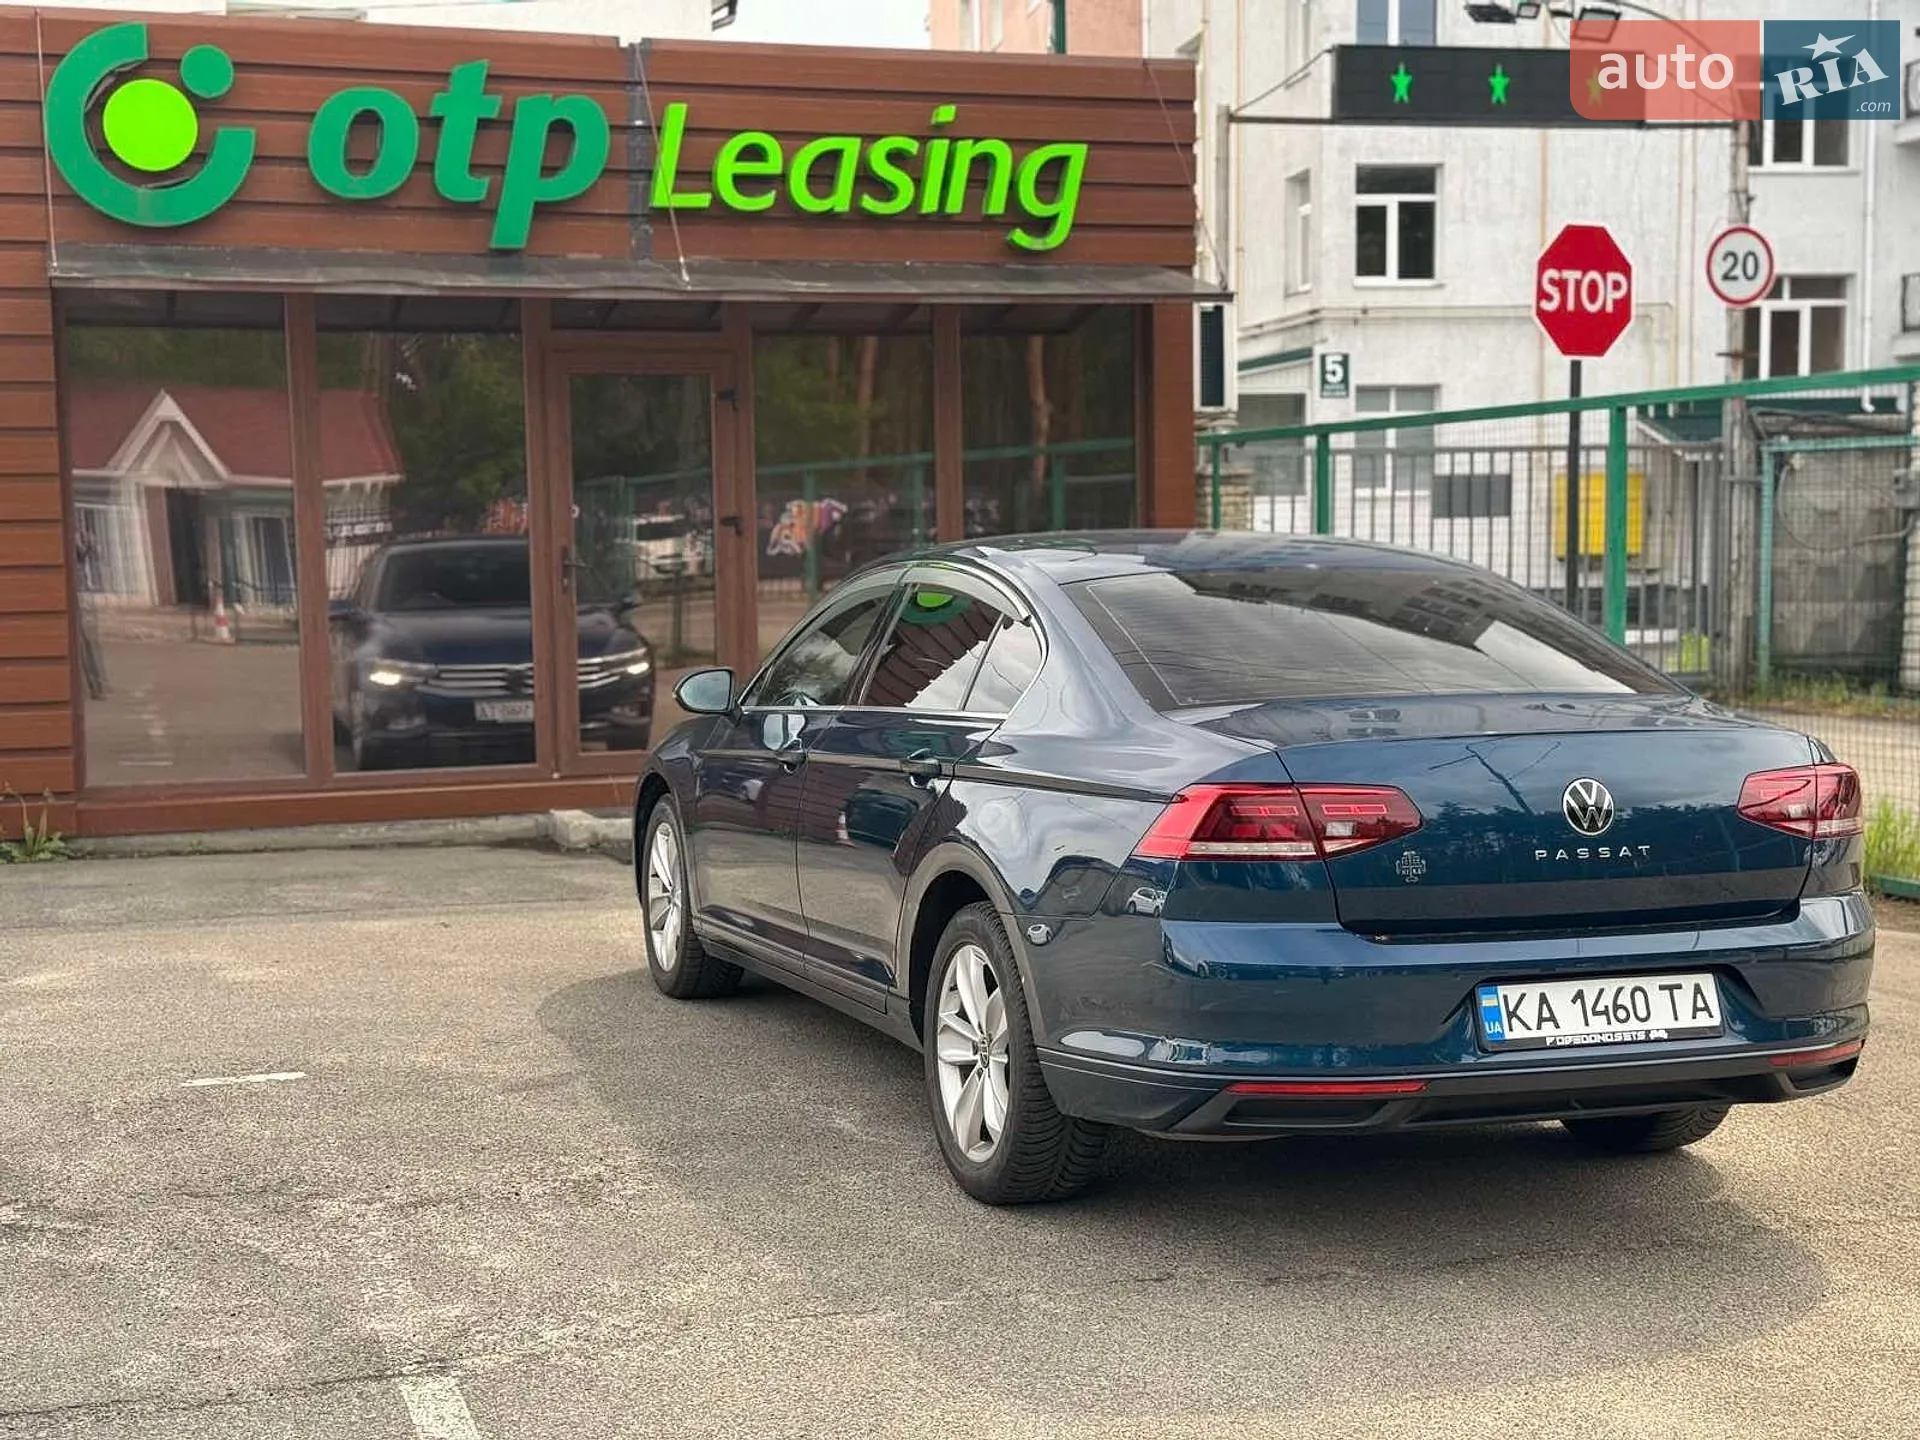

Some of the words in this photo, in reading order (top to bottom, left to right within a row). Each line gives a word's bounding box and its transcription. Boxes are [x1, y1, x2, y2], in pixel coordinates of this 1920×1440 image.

[307, 60, 610, 250] otp
[650, 102, 1089, 251] Leasing
[1721, 250, 1760, 282] 20
[1538, 267, 1629, 315] STOP
[1324, 355, 1345, 384] 5
[1534, 845, 1651, 861] PASSAT
[1502, 991, 1562, 1032] KA
[1570, 985, 1652, 1027] 1460
[1658, 982, 1715, 1021] TA
[1485, 1021, 1503, 1035] UA
